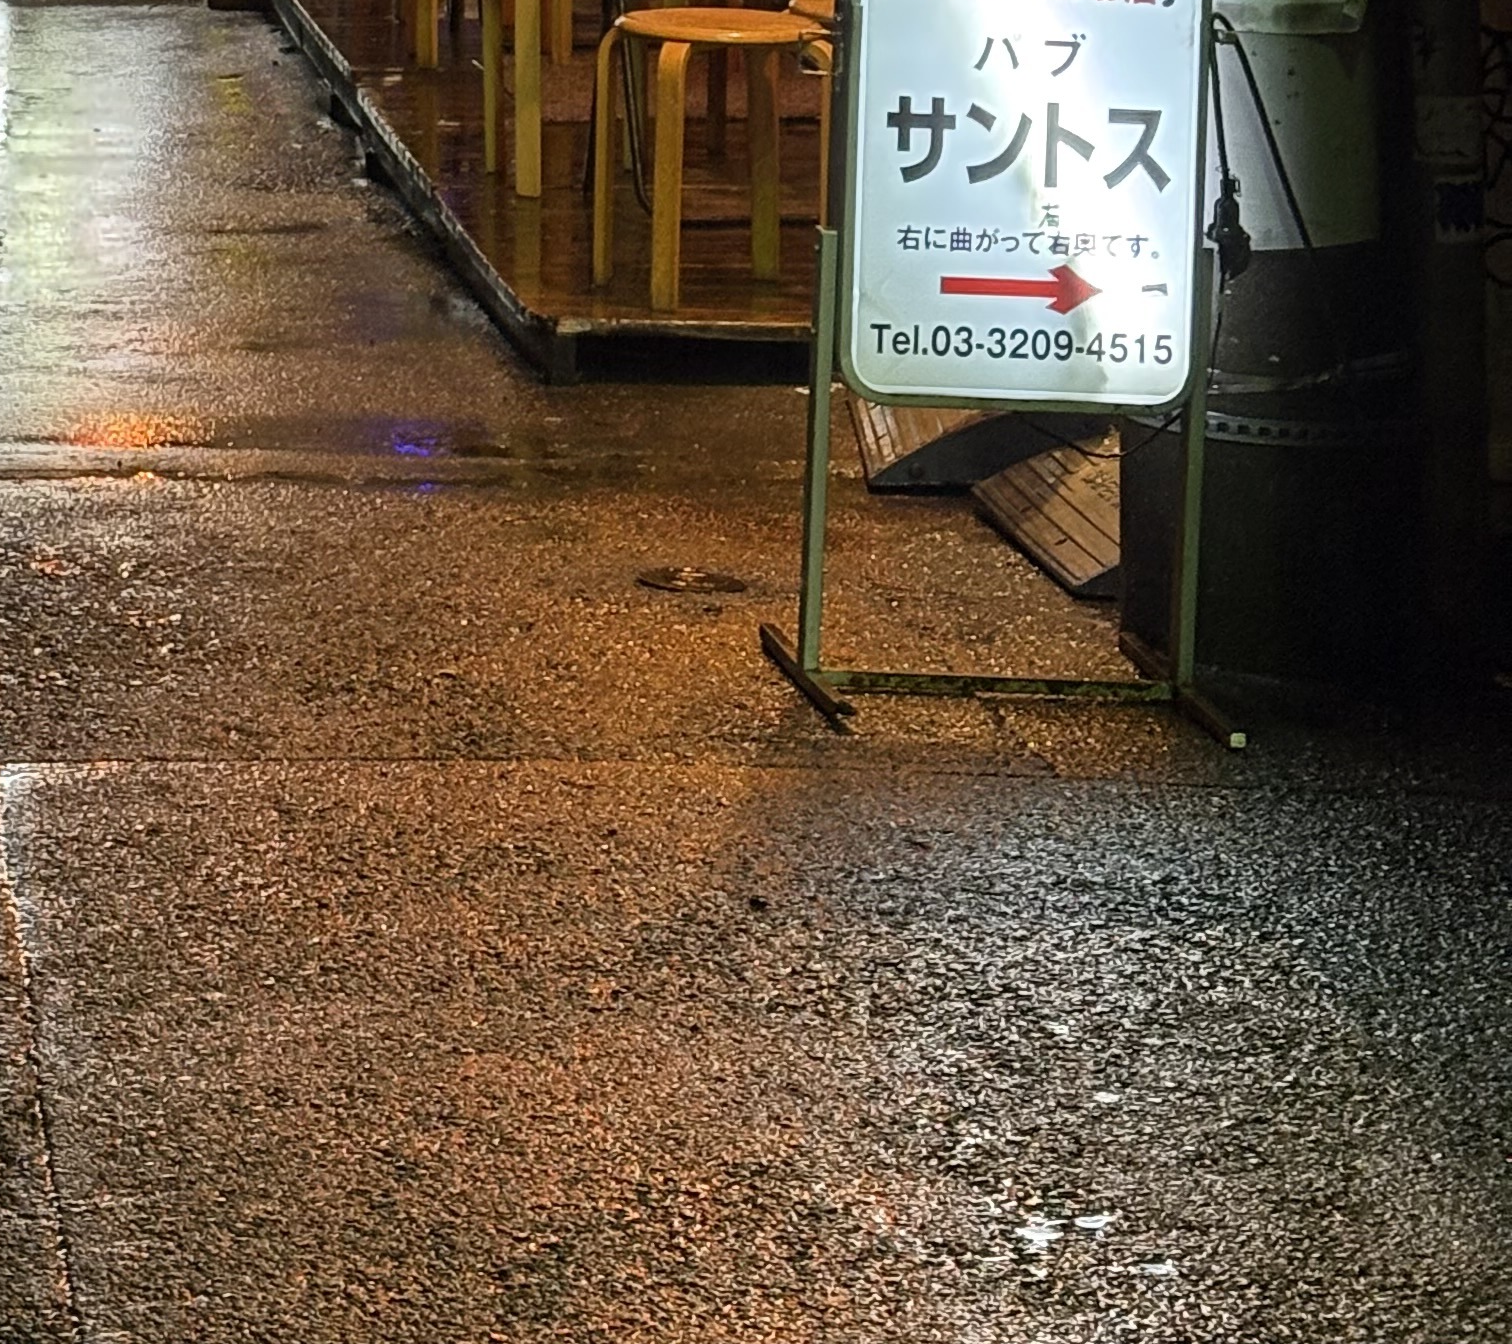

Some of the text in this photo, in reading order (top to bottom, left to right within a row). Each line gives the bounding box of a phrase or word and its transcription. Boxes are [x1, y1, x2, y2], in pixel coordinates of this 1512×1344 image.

[973, 33, 1088, 78] パブ
[886, 95, 1173, 194] サントス
[869, 323, 1174, 365] Tel.03-3209-4515
